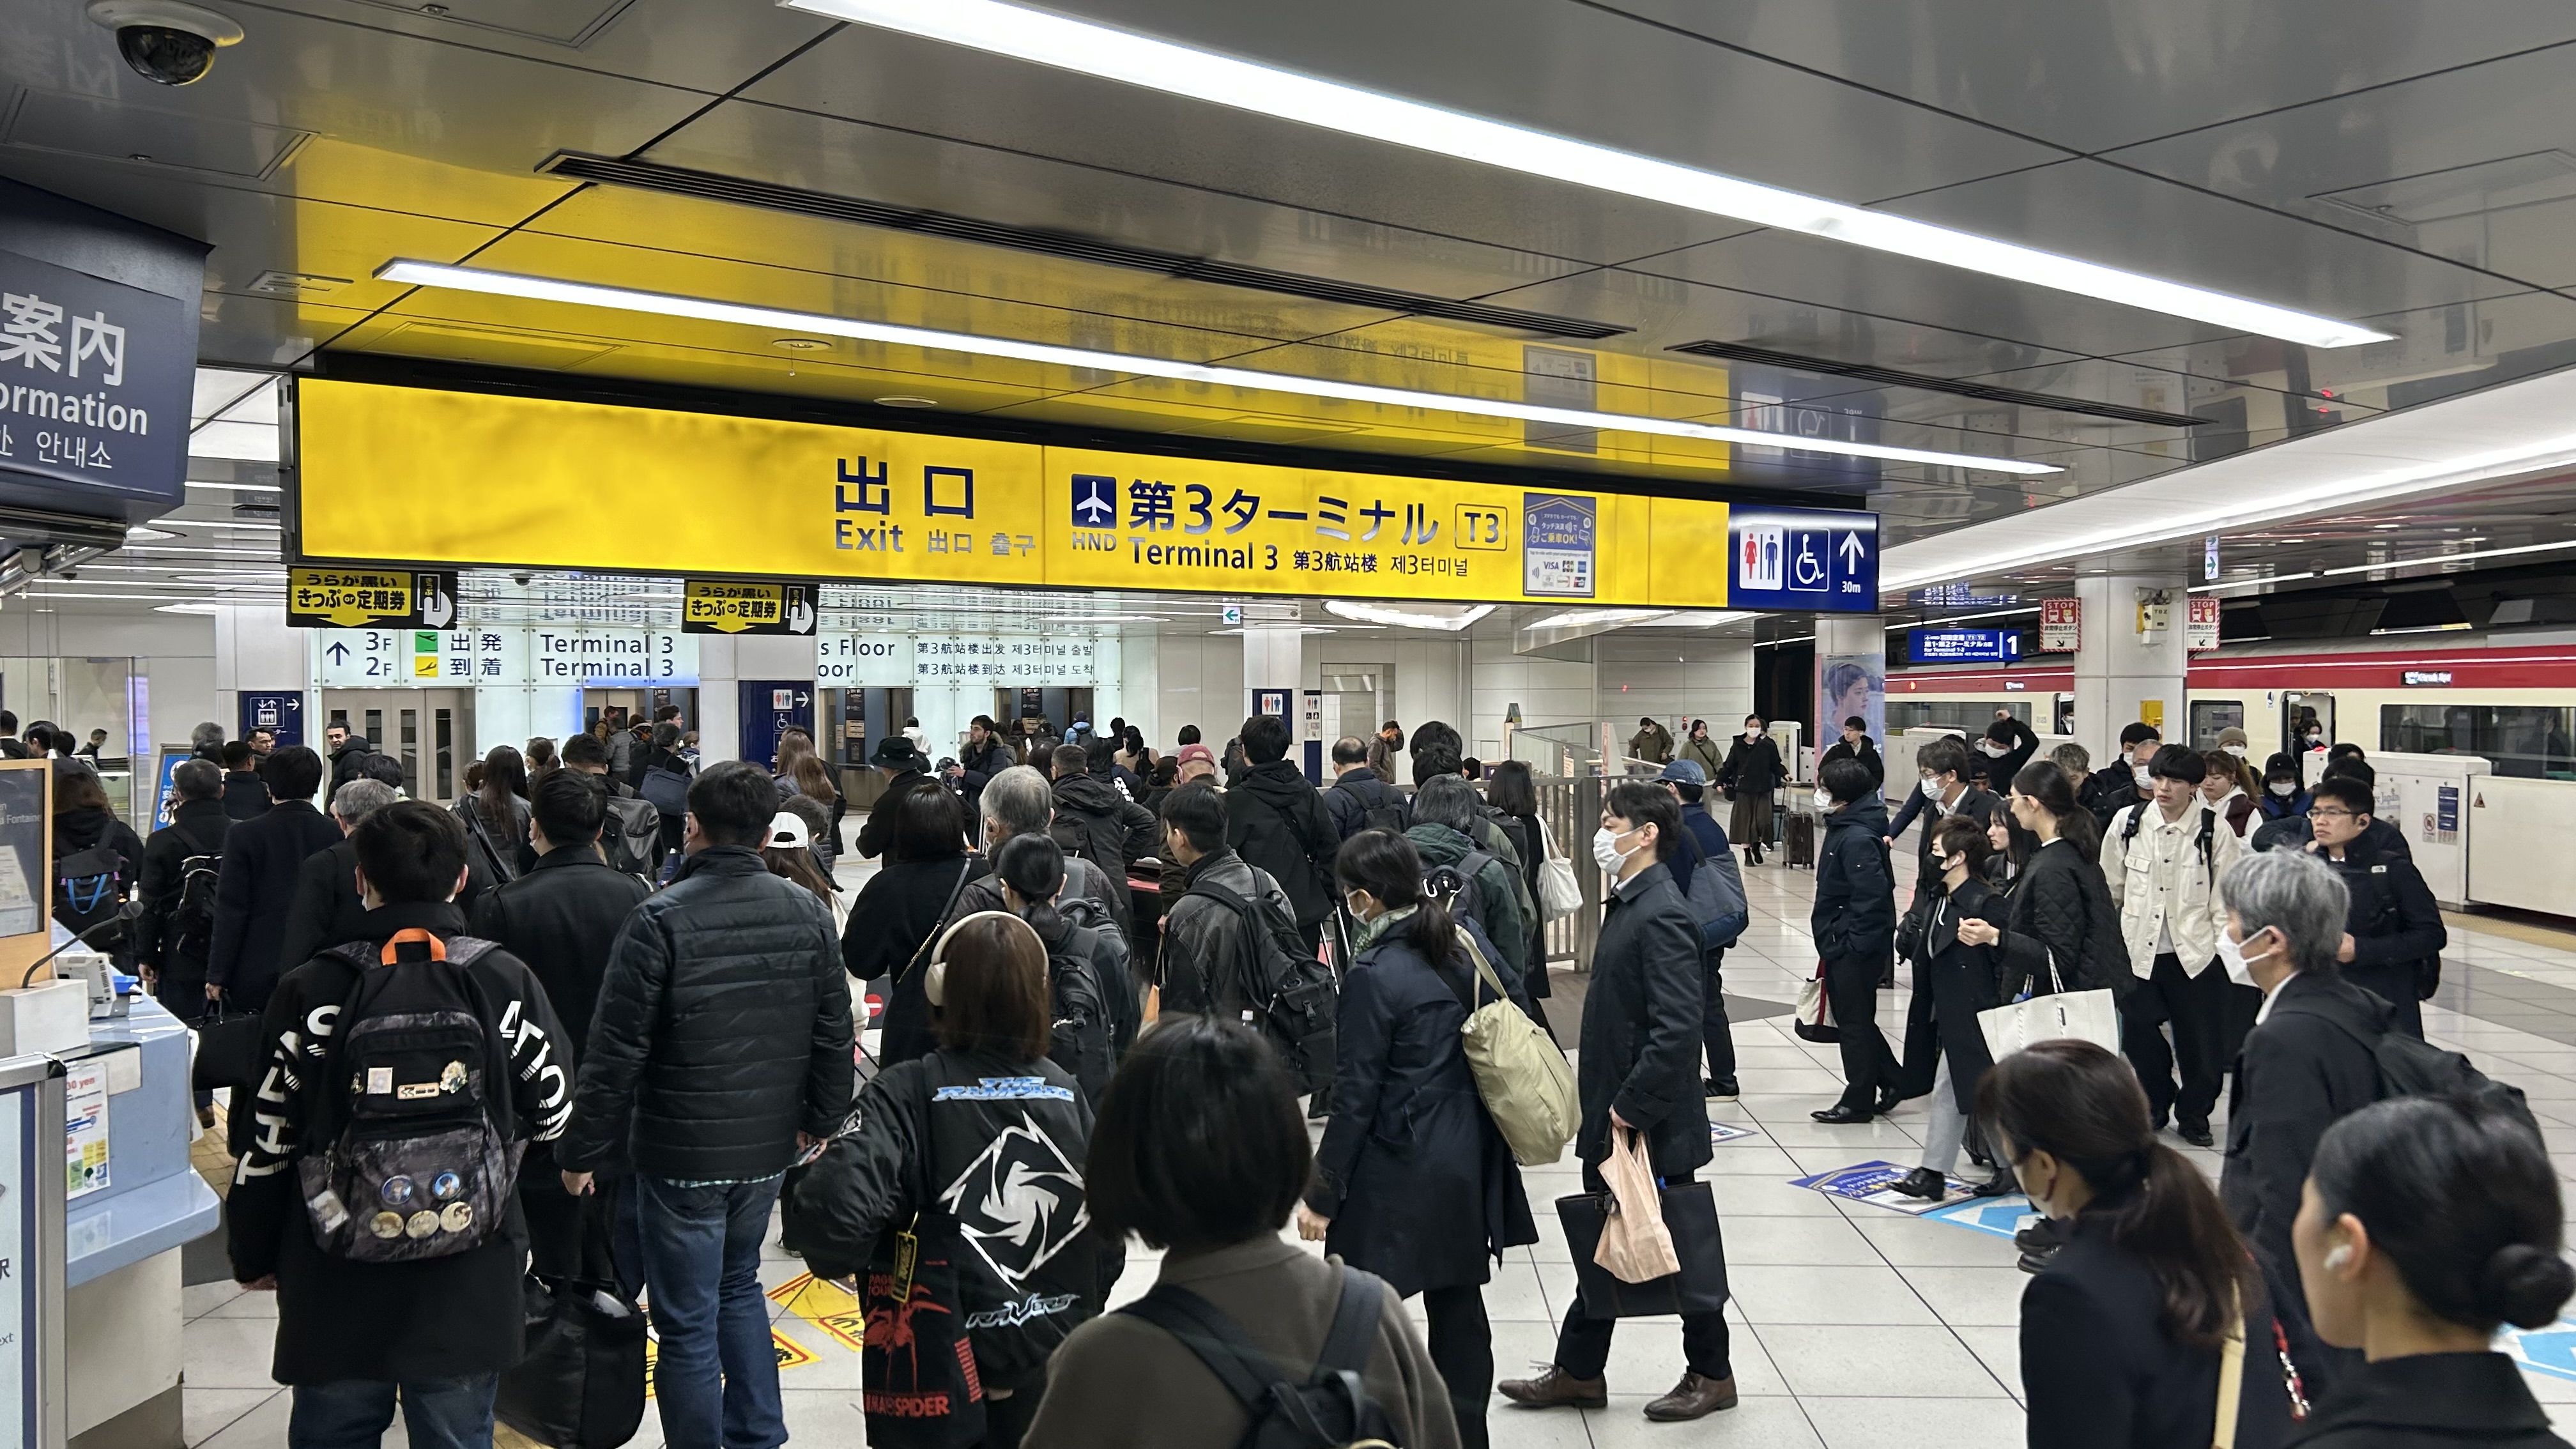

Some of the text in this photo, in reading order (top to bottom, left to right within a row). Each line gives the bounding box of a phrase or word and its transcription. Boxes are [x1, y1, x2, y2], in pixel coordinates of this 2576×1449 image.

[0, 293, 125, 387] 案内
[36, 431, 112, 468] 안내소
[835, 456, 974, 519] 出口
[1128, 479, 1439, 546] 第3ターミナル
[836, 519, 904, 553] Exit
[1464, 512, 1499, 544] T3
[928, 528, 972, 554] 出口
[990, 532, 1036, 557] 출구
[1071, 532, 1117, 552] HND
[1128, 537, 1279, 571] Terminal 3
[1292, 549, 1378, 574] 第3航站楼
[1390, 553, 1468, 578] 제3터미널
[1544, 561, 1559, 571] VISA
[306, 574, 397, 587] うらが黒い
[1841, 580, 1861, 594] 30m
[699, 586, 770, 599] うらが黒い
[365, 631, 392, 651] 3F
[450, 633, 502, 652] 出発
[540, 634, 674, 654] Terminal 3
[840, 638, 896, 657] Floor
[917, 642, 1006, 655] 第3航站楼出发
[1012, 643, 1066, 656] 제3터미널
[2007, 635, 2018, 656] 1
[365, 657, 392, 676] 2F
[450, 658, 502, 676] 到着
[540, 658, 674, 677] Terminal 3
[917, 663, 1006, 675] 第3航站楼到达
[1012, 664, 1066, 676] 제3터미널
[79, 1077, 95, 1089] yen
